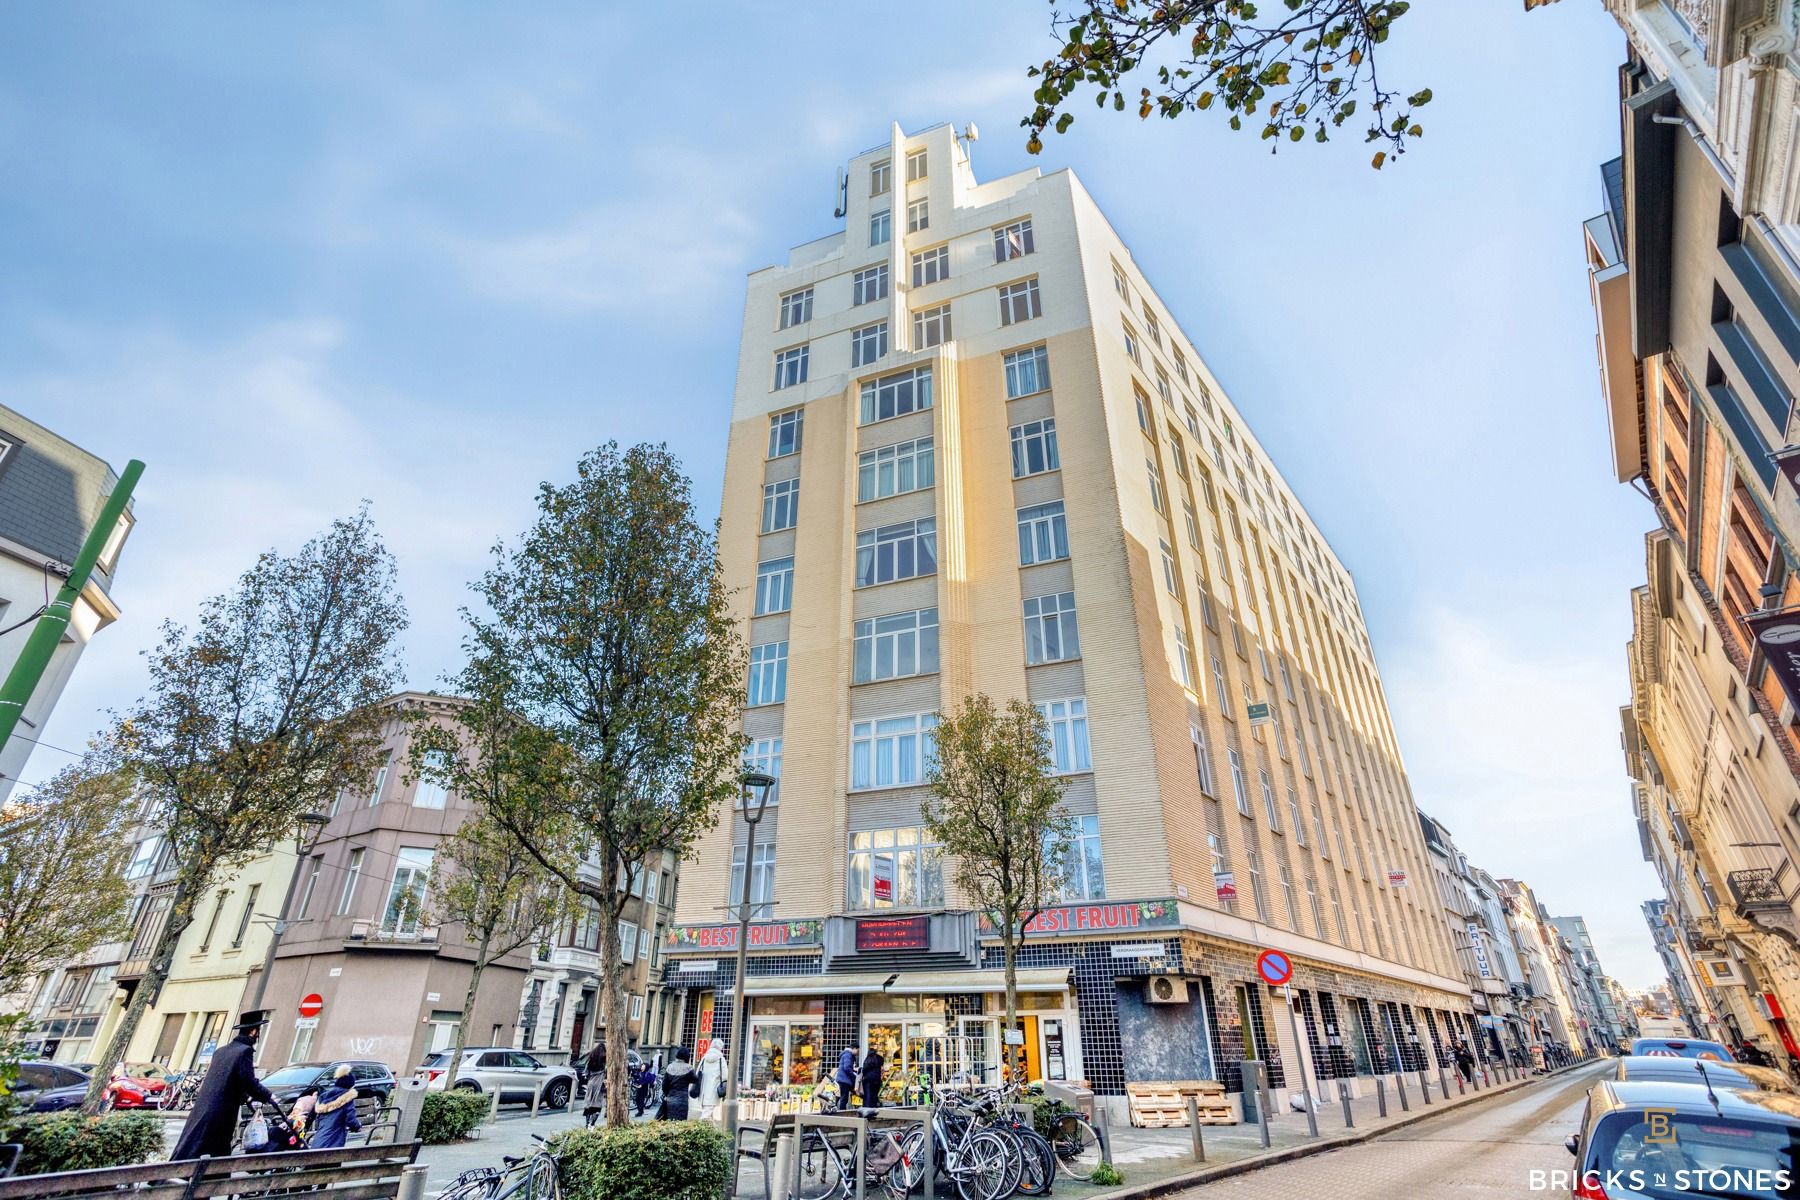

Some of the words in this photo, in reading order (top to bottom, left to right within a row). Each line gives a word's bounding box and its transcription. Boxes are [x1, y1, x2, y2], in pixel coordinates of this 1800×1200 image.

[1019, 908, 1070, 933] BEST
[1075, 903, 1139, 929] FRUIT
[700, 926, 738, 948] BEST
[747, 923, 789, 945] RUIT
[1468, 925, 1490, 977] FRITUUR
